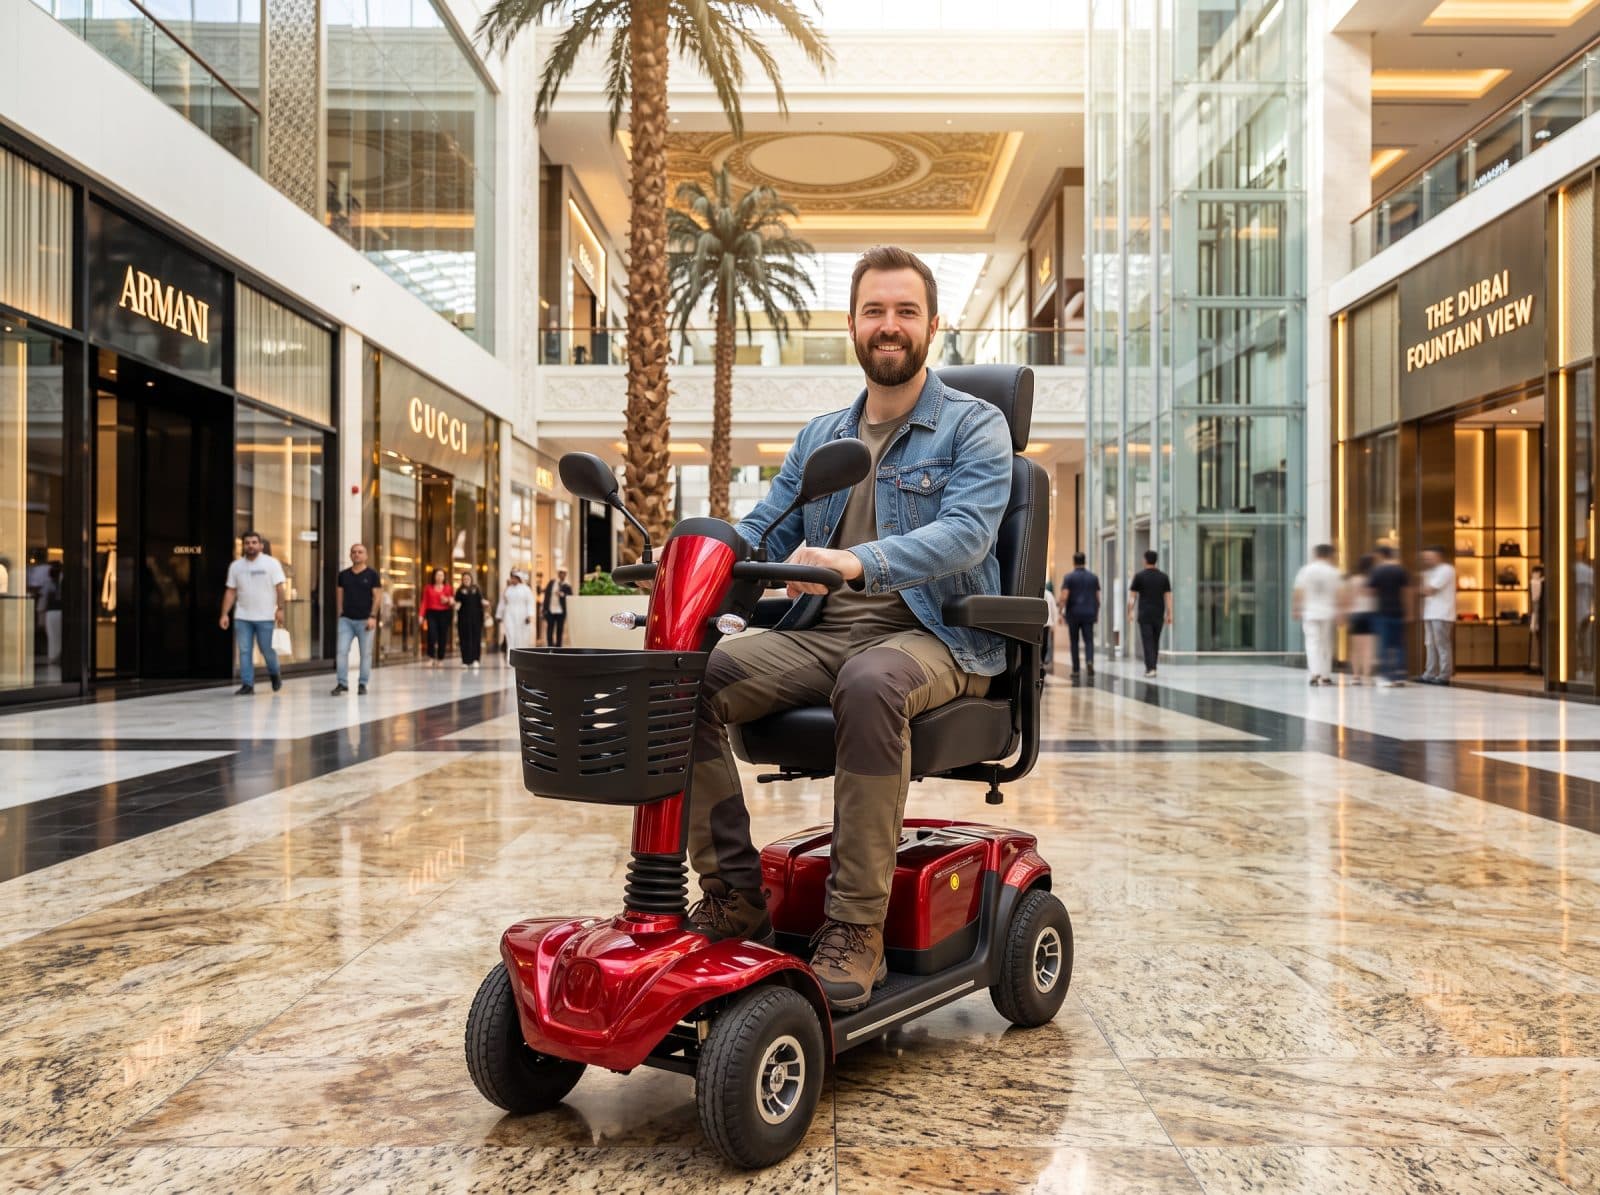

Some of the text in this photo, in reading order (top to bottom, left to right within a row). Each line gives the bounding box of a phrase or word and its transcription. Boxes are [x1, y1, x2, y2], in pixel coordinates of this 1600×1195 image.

[119, 265, 209, 343] ARMANI
[1407, 294, 1533, 372] FOUNTAIN VIEW
[1425, 269, 1508, 331] THE DUBAI
[409, 397, 467, 455] GUCCI
